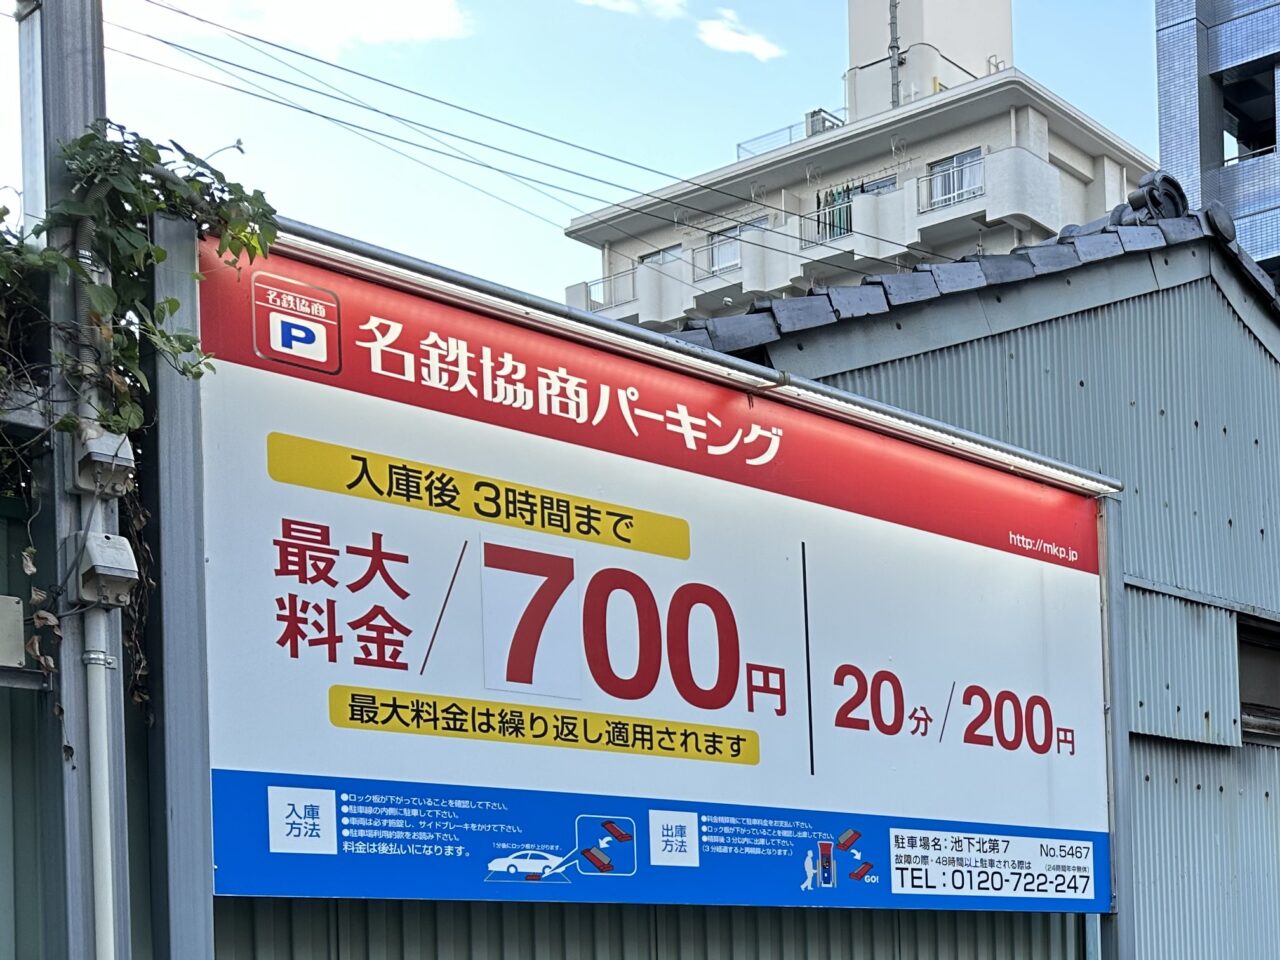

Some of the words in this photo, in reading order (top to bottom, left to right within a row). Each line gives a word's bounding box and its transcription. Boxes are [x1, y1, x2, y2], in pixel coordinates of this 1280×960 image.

[266, 289, 326, 317] 名鉄協商
[281, 320, 316, 349] P
[355, 315, 784, 467] 名鉄協商パーキング
[1009, 531, 1078, 561] http://mkp.jp
[272, 518, 411, 600] 最大
[276, 593, 414, 671] 料金
[349, 693, 747, 758] 最大料金は繰り返し適用されます
[285, 803, 320, 821] 入庫
[285, 820, 321, 838] 方法
[661, 824, 687, 838] 出庫
[343, 841, 470, 857] 料金は後払いになります。
[661, 838, 688, 853] 方法
[1040, 843, 1091, 860] No.5467
[864, 875, 880, 884] GO!
